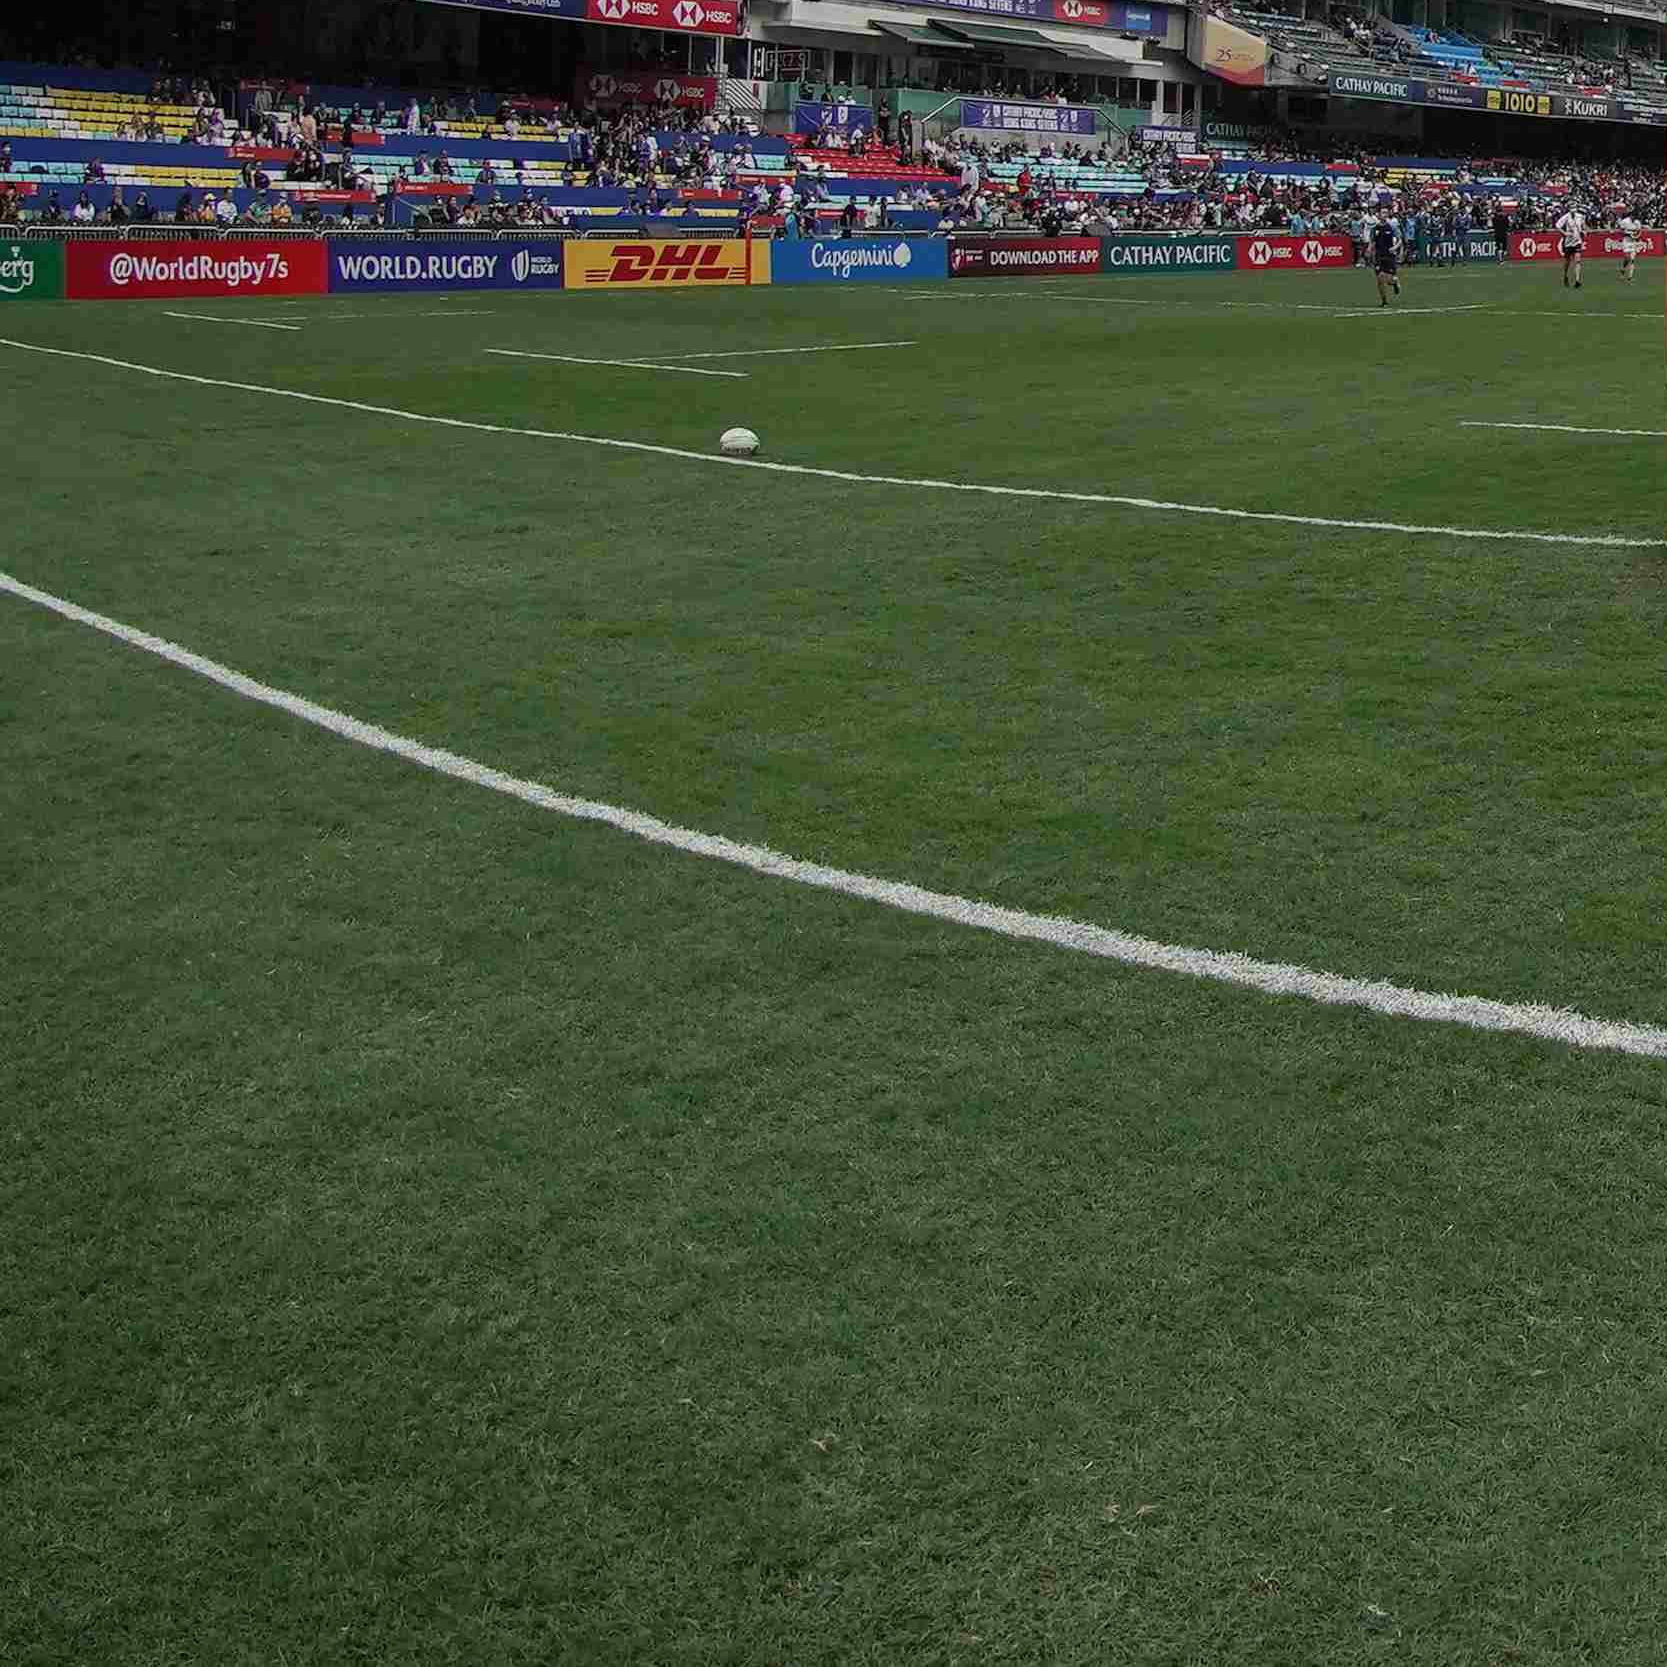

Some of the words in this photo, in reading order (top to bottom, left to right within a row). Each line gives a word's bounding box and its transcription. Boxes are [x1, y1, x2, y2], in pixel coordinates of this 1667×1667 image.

[631, 1, 659, 17] HSBC
[705, 9, 733, 25] HSBC
[1216, 47, 1233, 62] 25
[1334, 76, 1372, 94] CATHAY
[1373, 79, 1408, 98] PACIFIC
[1504, 92, 1536, 113] 1010
[1573, 99, 1608, 118] KUKRI
[607, 244, 731, 282] DHL
[811, 242, 894, 278] Capgemini
[989, 249, 1056, 266] DOWNLOAD
[1056, 249, 1077, 265] THE
[1079, 248, 1099, 264] APP
[1110, 245, 1174, 266] CATHAY
[1175, 244, 1231, 265] PACIFIC
[110, 252, 289, 286] @WorldRugby7s
[337, 252, 498, 281] WORLD.RUGBY
[530, 262, 560, 275] RUGBY
